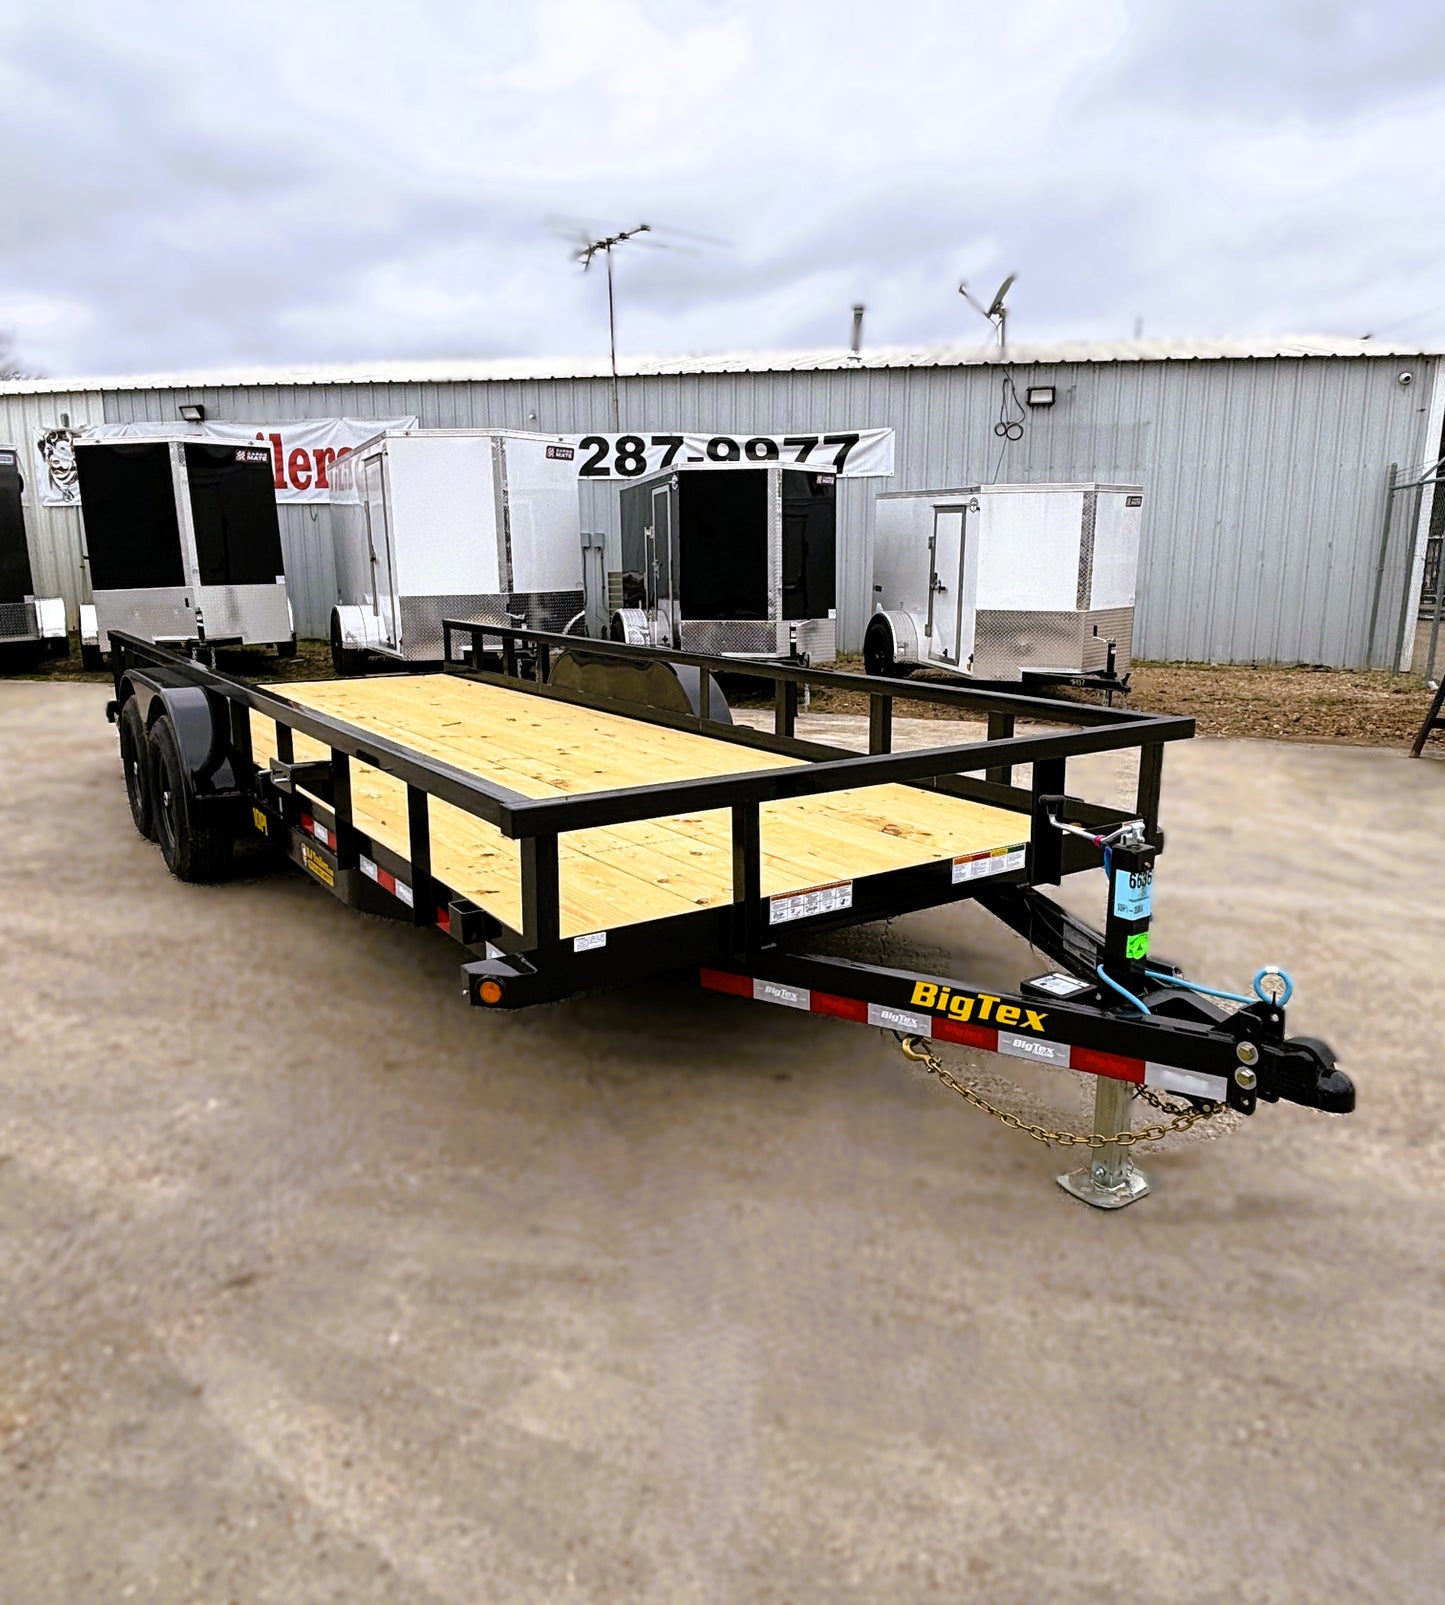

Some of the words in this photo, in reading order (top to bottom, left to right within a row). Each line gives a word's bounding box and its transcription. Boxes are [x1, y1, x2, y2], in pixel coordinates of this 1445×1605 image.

[579, 434, 859, 477] 287-9977
[764, 985, 798, 1000] BigTex
[910, 980, 1050, 1033] BigTex
[881, 1010, 918, 1026] BigTex
[1012, 1039, 1055, 1056] BigTex
